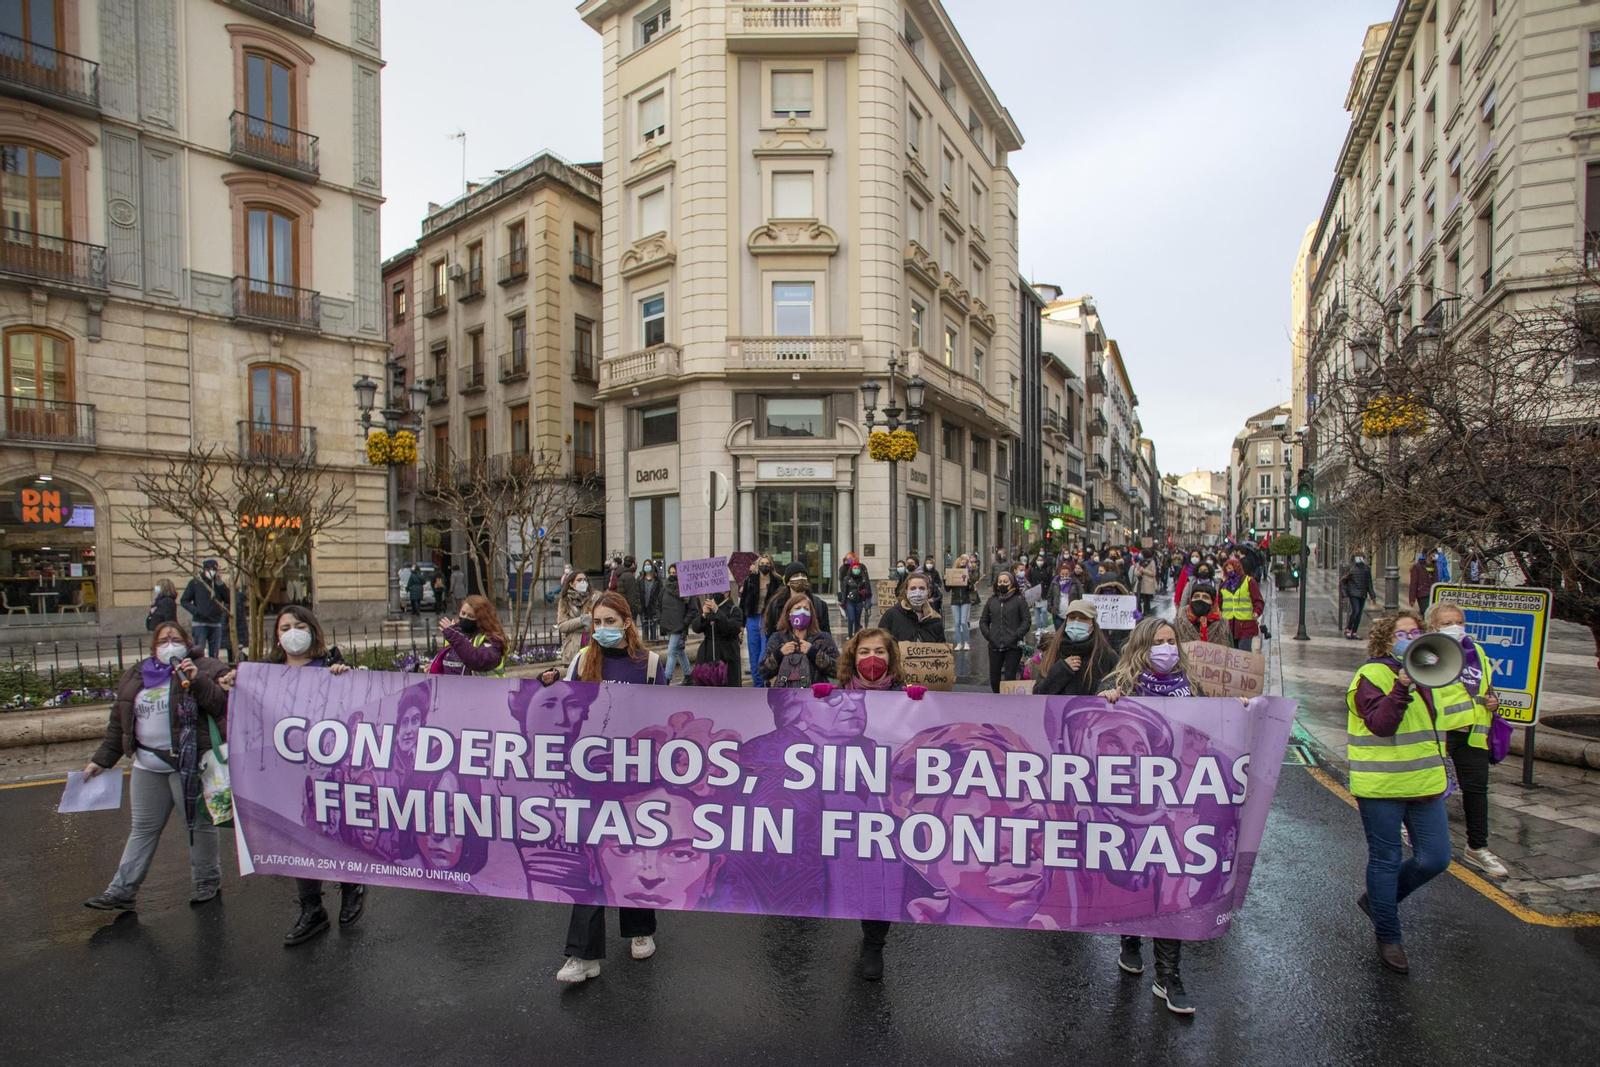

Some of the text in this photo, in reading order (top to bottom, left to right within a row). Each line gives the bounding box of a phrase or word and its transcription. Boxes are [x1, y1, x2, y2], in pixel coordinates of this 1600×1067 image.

[636, 468, 669, 482] Bankia
[777, 466, 815, 477] Bankia
[22, 489, 60, 506] DN
[679, 564, 689, 573] UN
[682, 583, 692, 591] UN
[1441, 590, 1471, 599] CARRIL
[1499, 601, 1541, 611] PROTEGIDO
[1187, 644, 1251, 670] HOMBRES
[1490, 658, 1513, 676] XI
[906, 674, 921, 684] DEL
[1241, 675, 1257, 690] NO
[1499, 699, 1523, 708] ZADOS
[273, 717, 394, 769] CON
[413, 727, 759, 794] DERECHOS,
[783, 743, 887, 793] SIN
[314, 780, 1231, 875] FEMINISTAS SIN FRONTERAS.
[253, 854, 316, 868] PLATAFORMA
[318, 858, 337, 870] 25N
[339, 860, 345, 870] Y
[347, 860, 362, 872] 8M
[370, 864, 424, 878] FEMINISMO
[426, 869, 471, 883] UNITARIO
